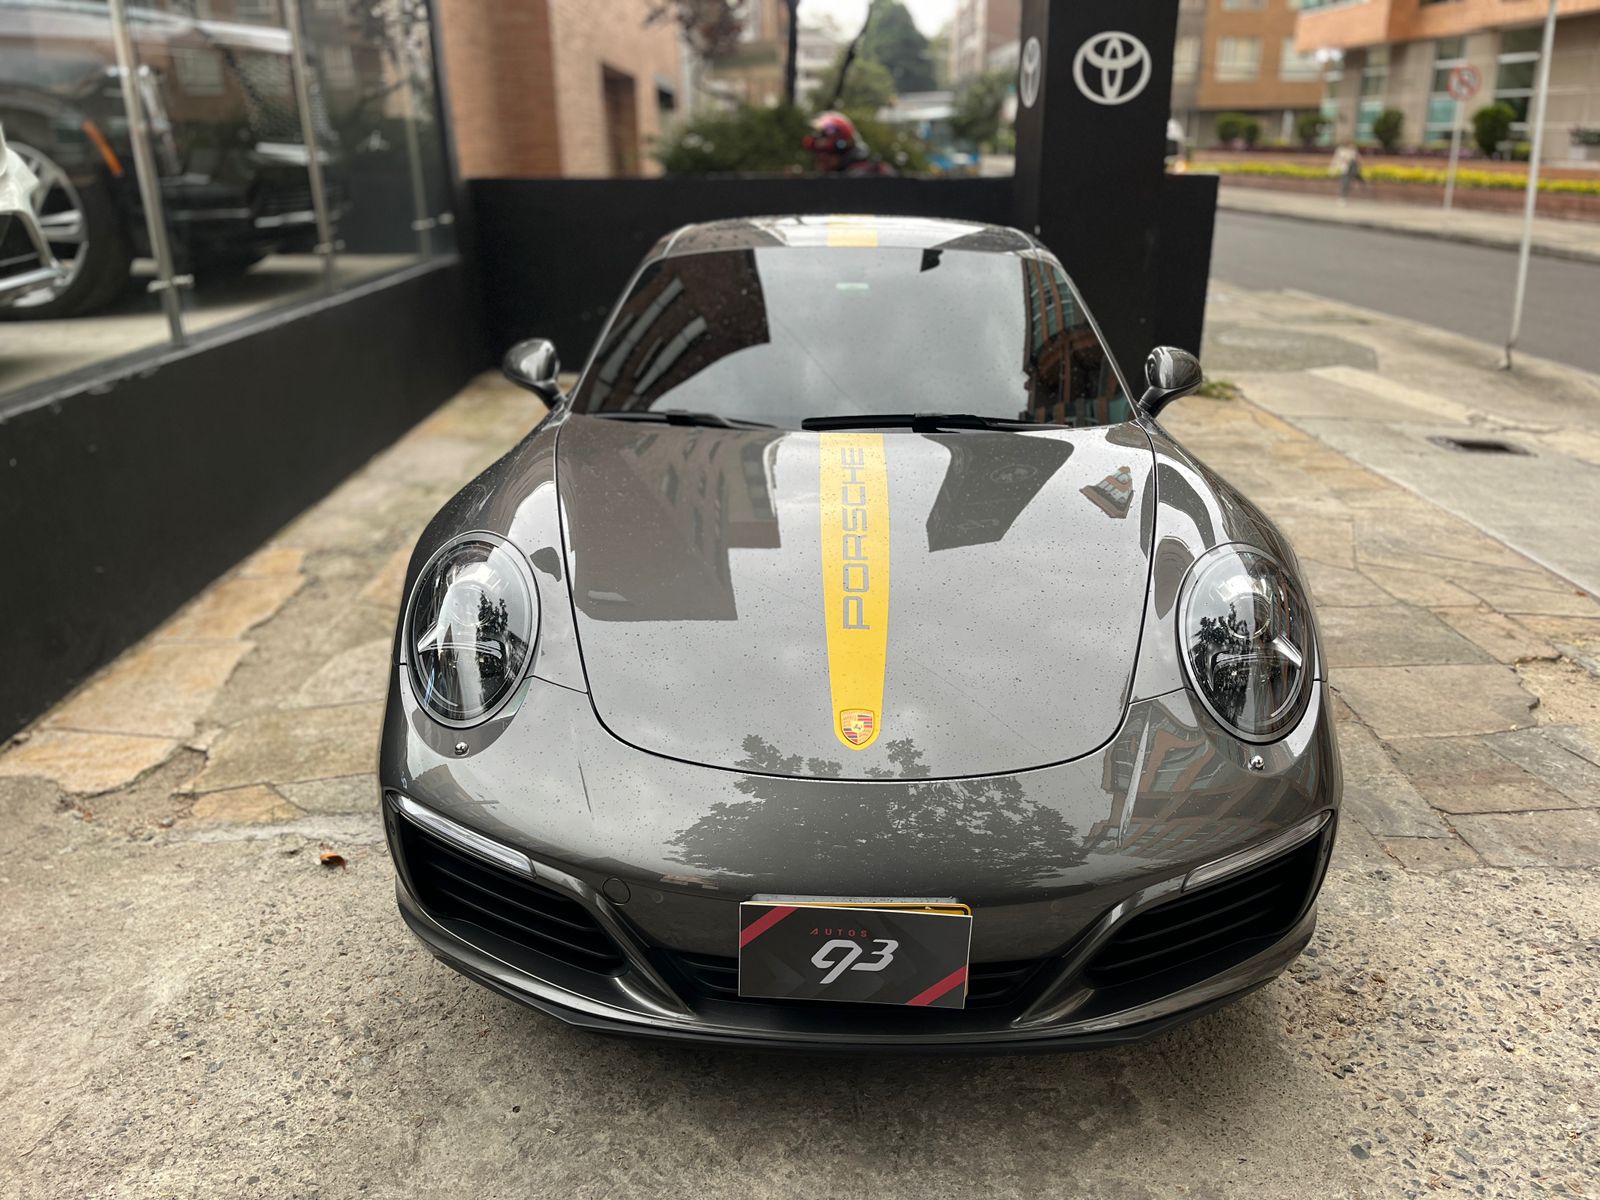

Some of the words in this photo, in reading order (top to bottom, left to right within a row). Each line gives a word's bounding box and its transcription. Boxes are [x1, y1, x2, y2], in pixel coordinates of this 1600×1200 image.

[840, 447, 870, 630] PORSCHE
[810, 928, 868, 938] AUTOS
[811, 939, 899, 984] 93
